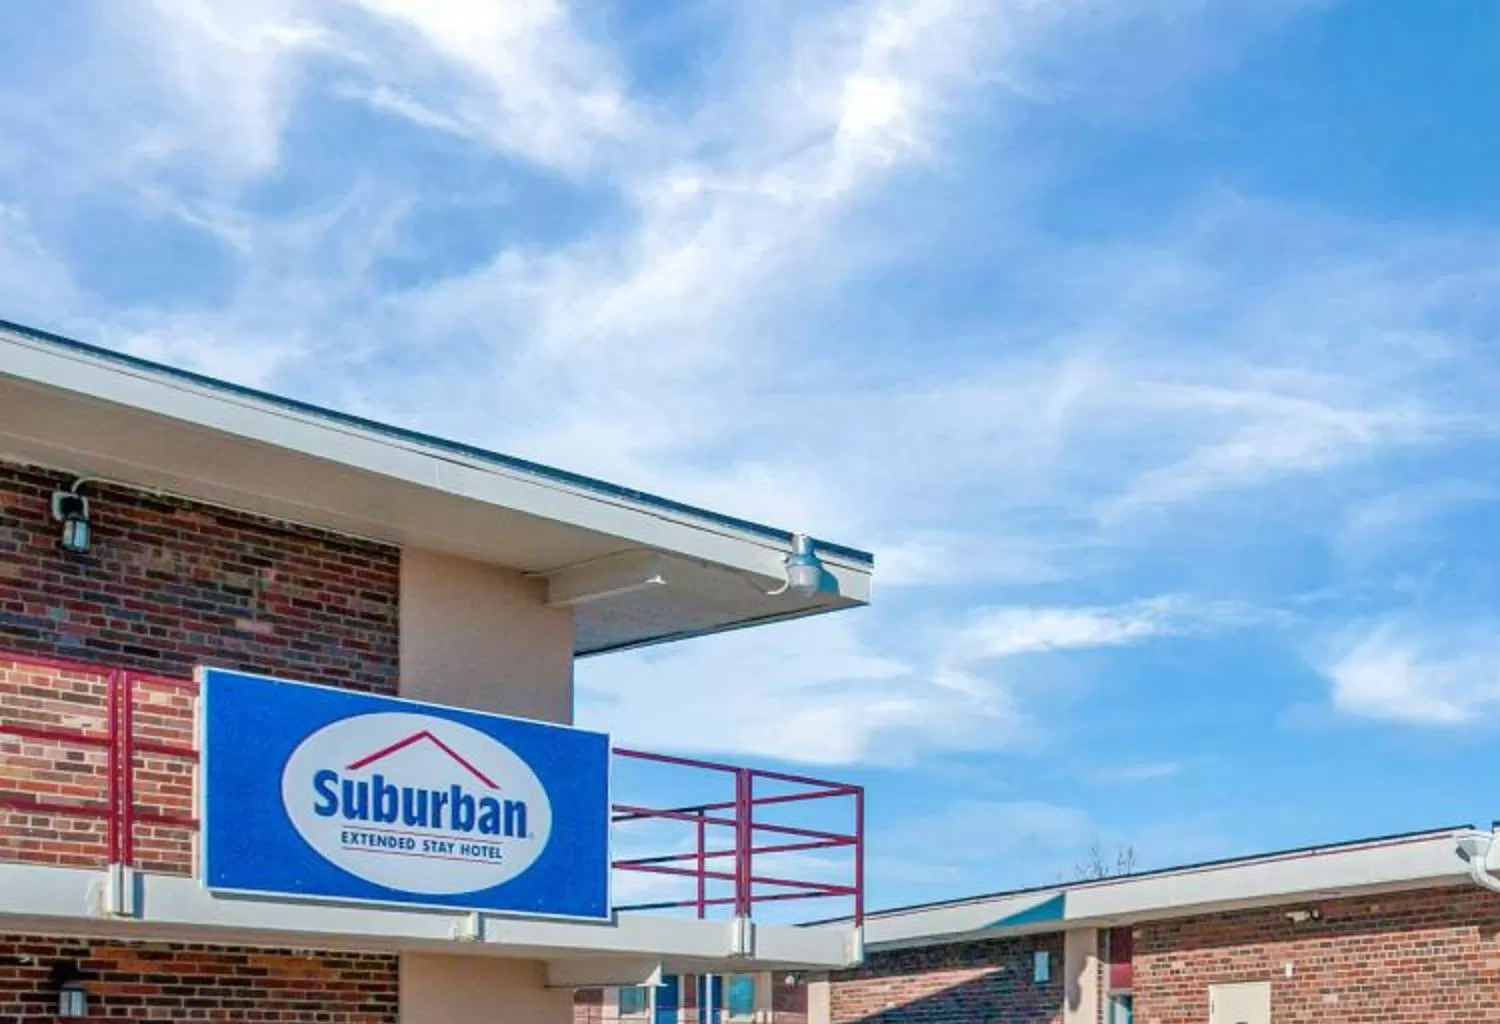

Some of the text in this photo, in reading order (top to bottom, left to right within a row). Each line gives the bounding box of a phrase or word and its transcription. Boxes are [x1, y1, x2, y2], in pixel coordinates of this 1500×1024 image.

[313, 769, 527, 838] Suburban
[341, 831, 503, 859] EXTENDED STAY HOTEL
